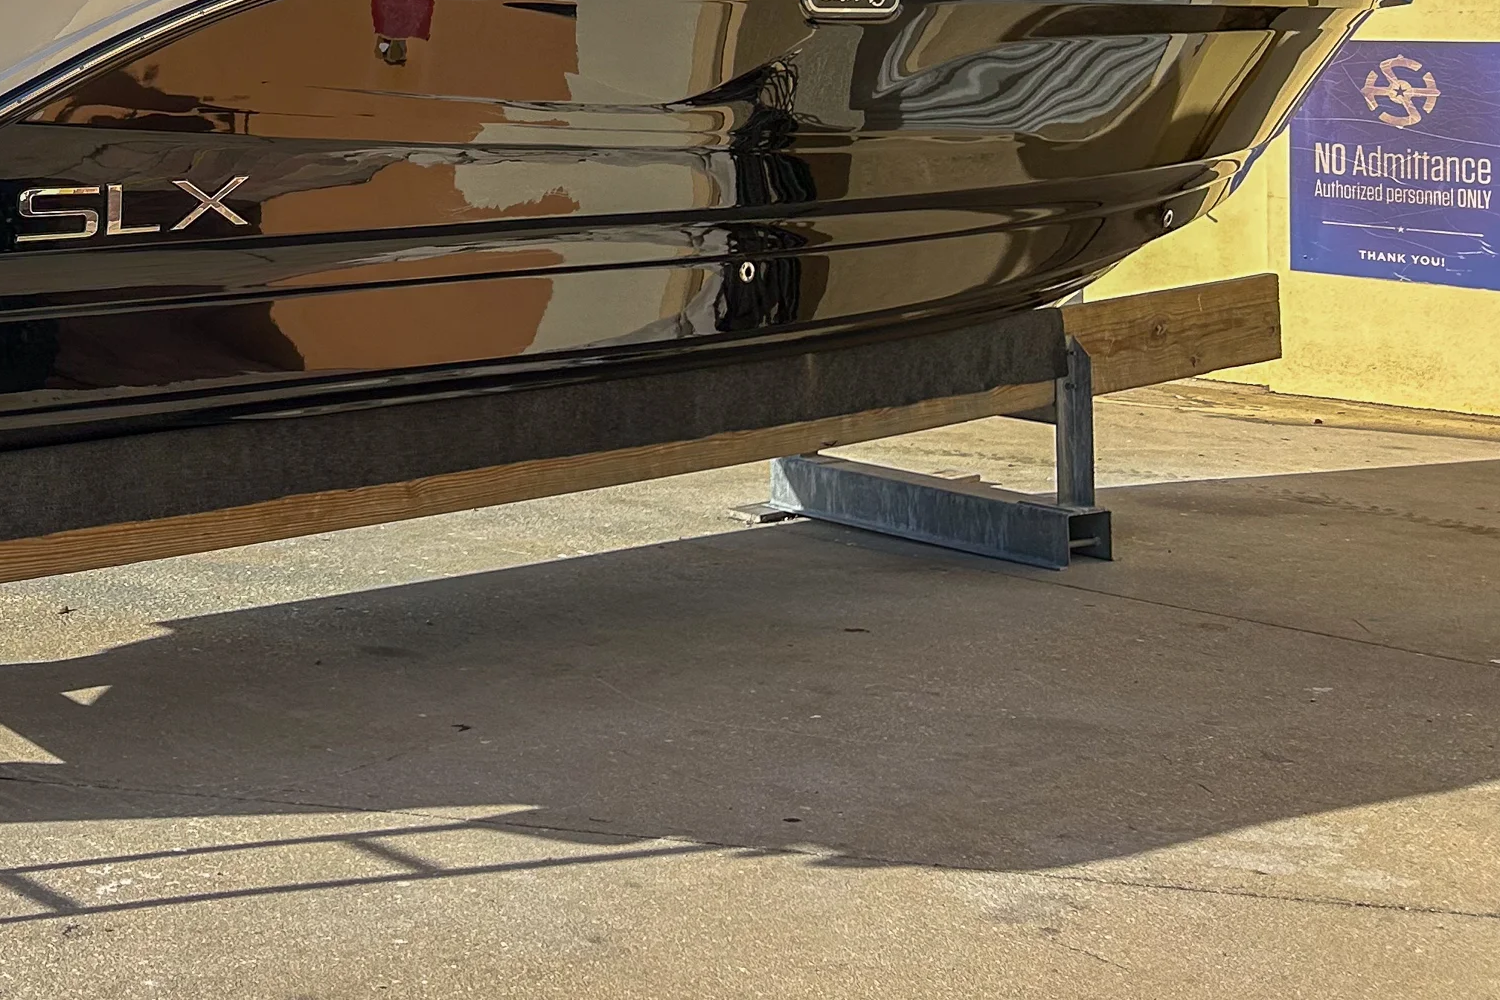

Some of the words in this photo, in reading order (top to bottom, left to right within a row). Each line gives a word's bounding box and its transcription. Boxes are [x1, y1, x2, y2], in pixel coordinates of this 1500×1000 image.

[1314, 142, 1346, 176] NO
[1352, 144, 1493, 186] Admittance
[15, 174, 251, 244] SLX
[1314, 178, 1384, 202] Authorized
[1386, 183, 1455, 208] personnel
[1457, 188, 1493, 210] ONLY
[1358, 249, 1407, 264] THANK
[1411, 254, 1446, 268] YOU!
